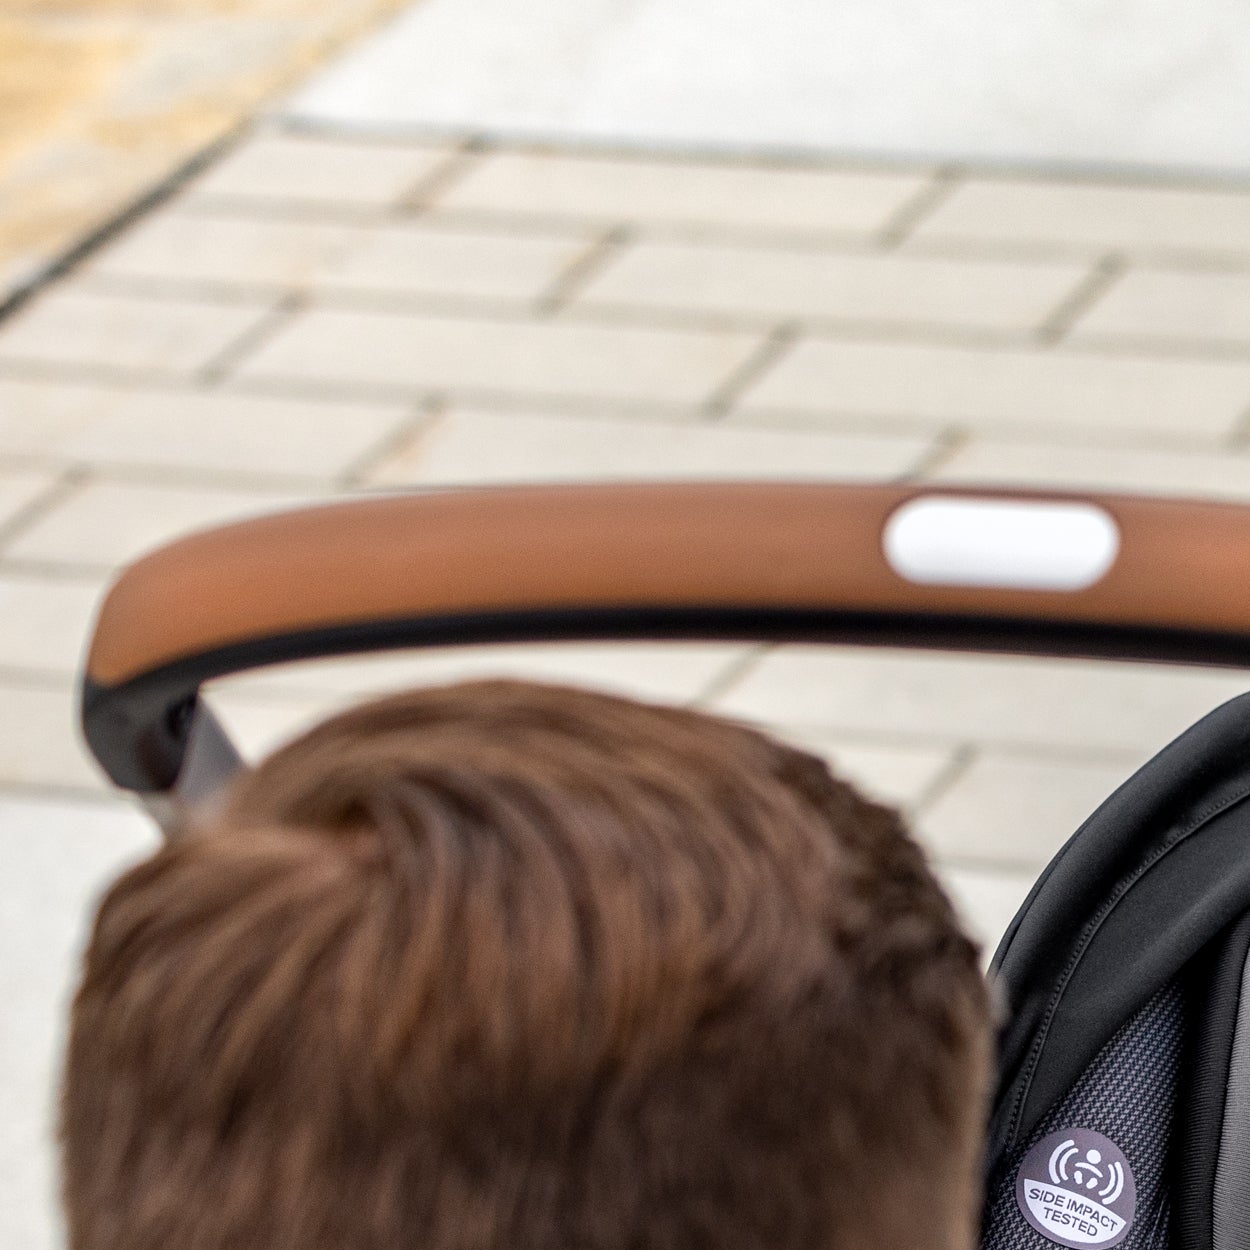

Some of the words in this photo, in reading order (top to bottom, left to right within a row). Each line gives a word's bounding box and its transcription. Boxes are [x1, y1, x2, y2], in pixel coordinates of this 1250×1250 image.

[1028, 1188, 1066, 1208] SIDE
[1066, 1198, 1118, 1232] IMPACT
[1043, 1206, 1098, 1237] TESTED
